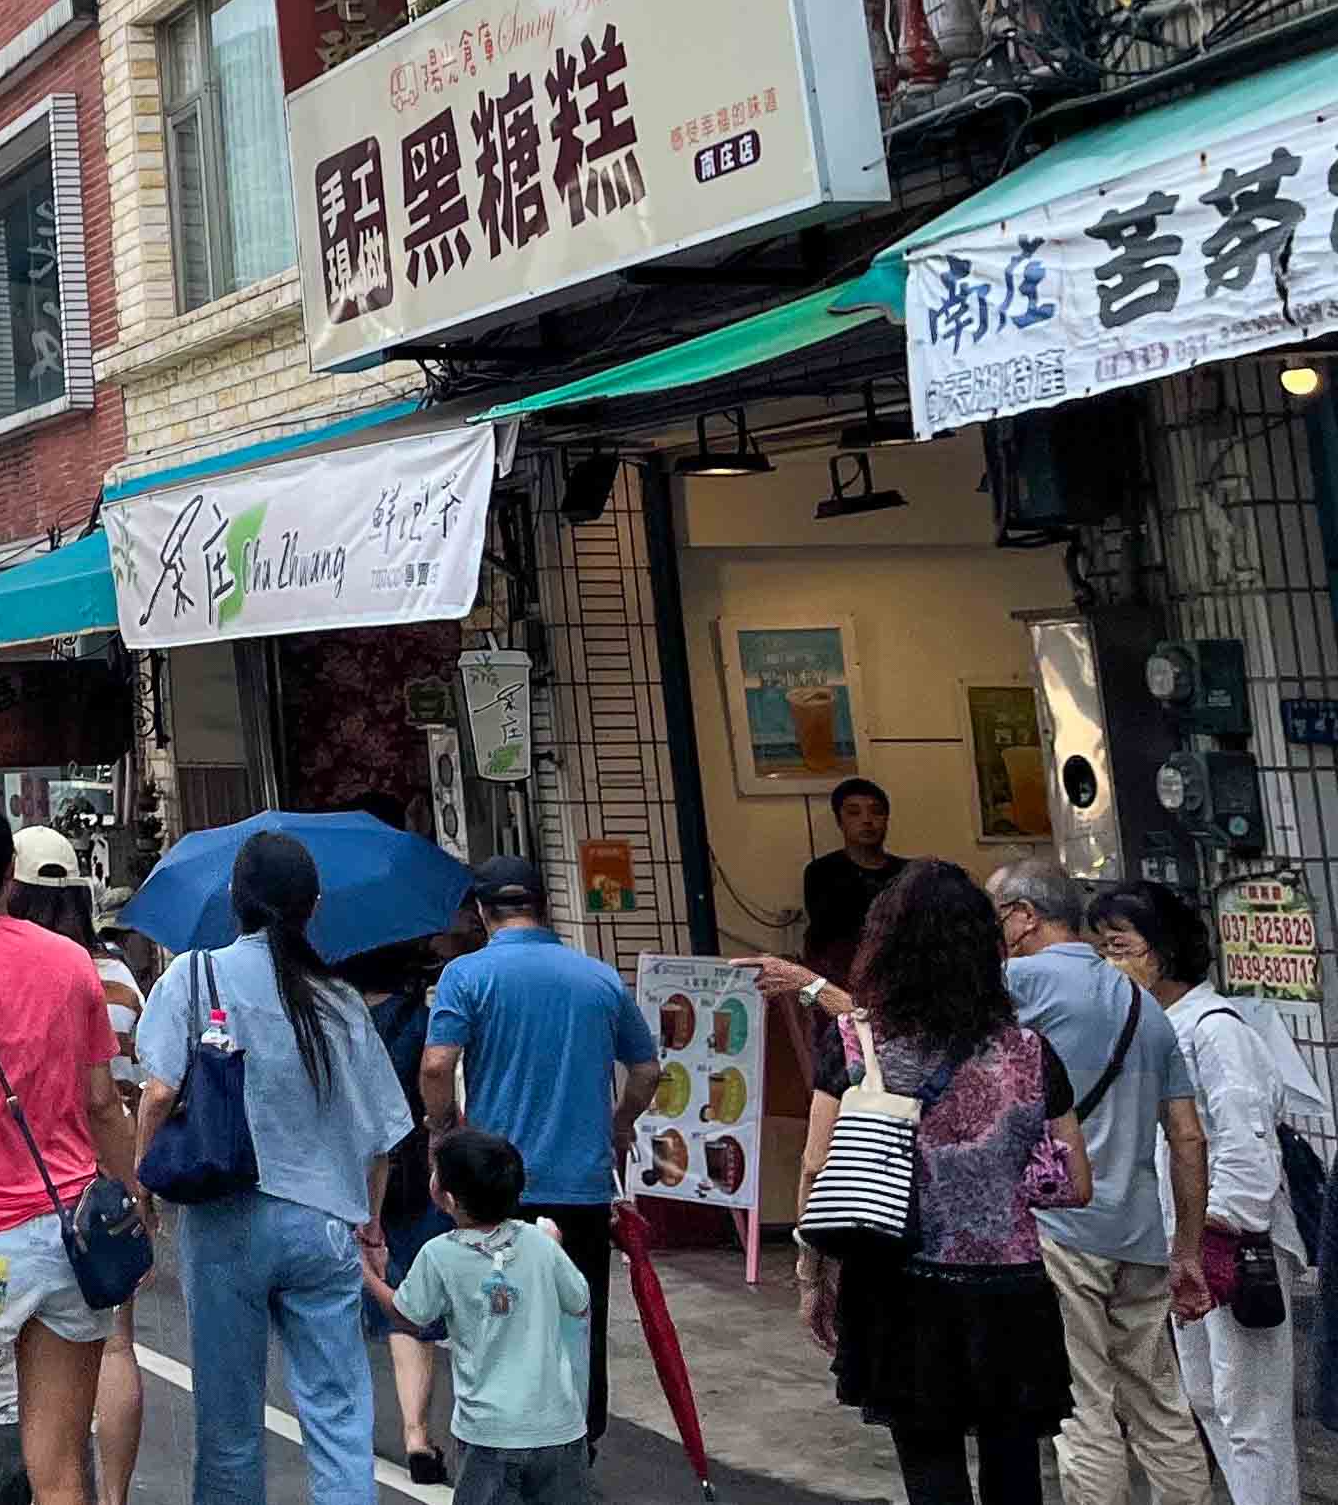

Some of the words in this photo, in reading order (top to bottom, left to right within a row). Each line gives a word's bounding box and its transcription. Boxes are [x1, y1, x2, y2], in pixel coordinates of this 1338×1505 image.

[401, 23, 647, 289] 黑糖糕
[321, 158, 381, 239] 手工
[325, 225, 388, 305] 現做
[928, 233, 1057, 355] 南庄
[243, 540, 271, 595] Cha
[278, 530, 347, 599] Zhuang
